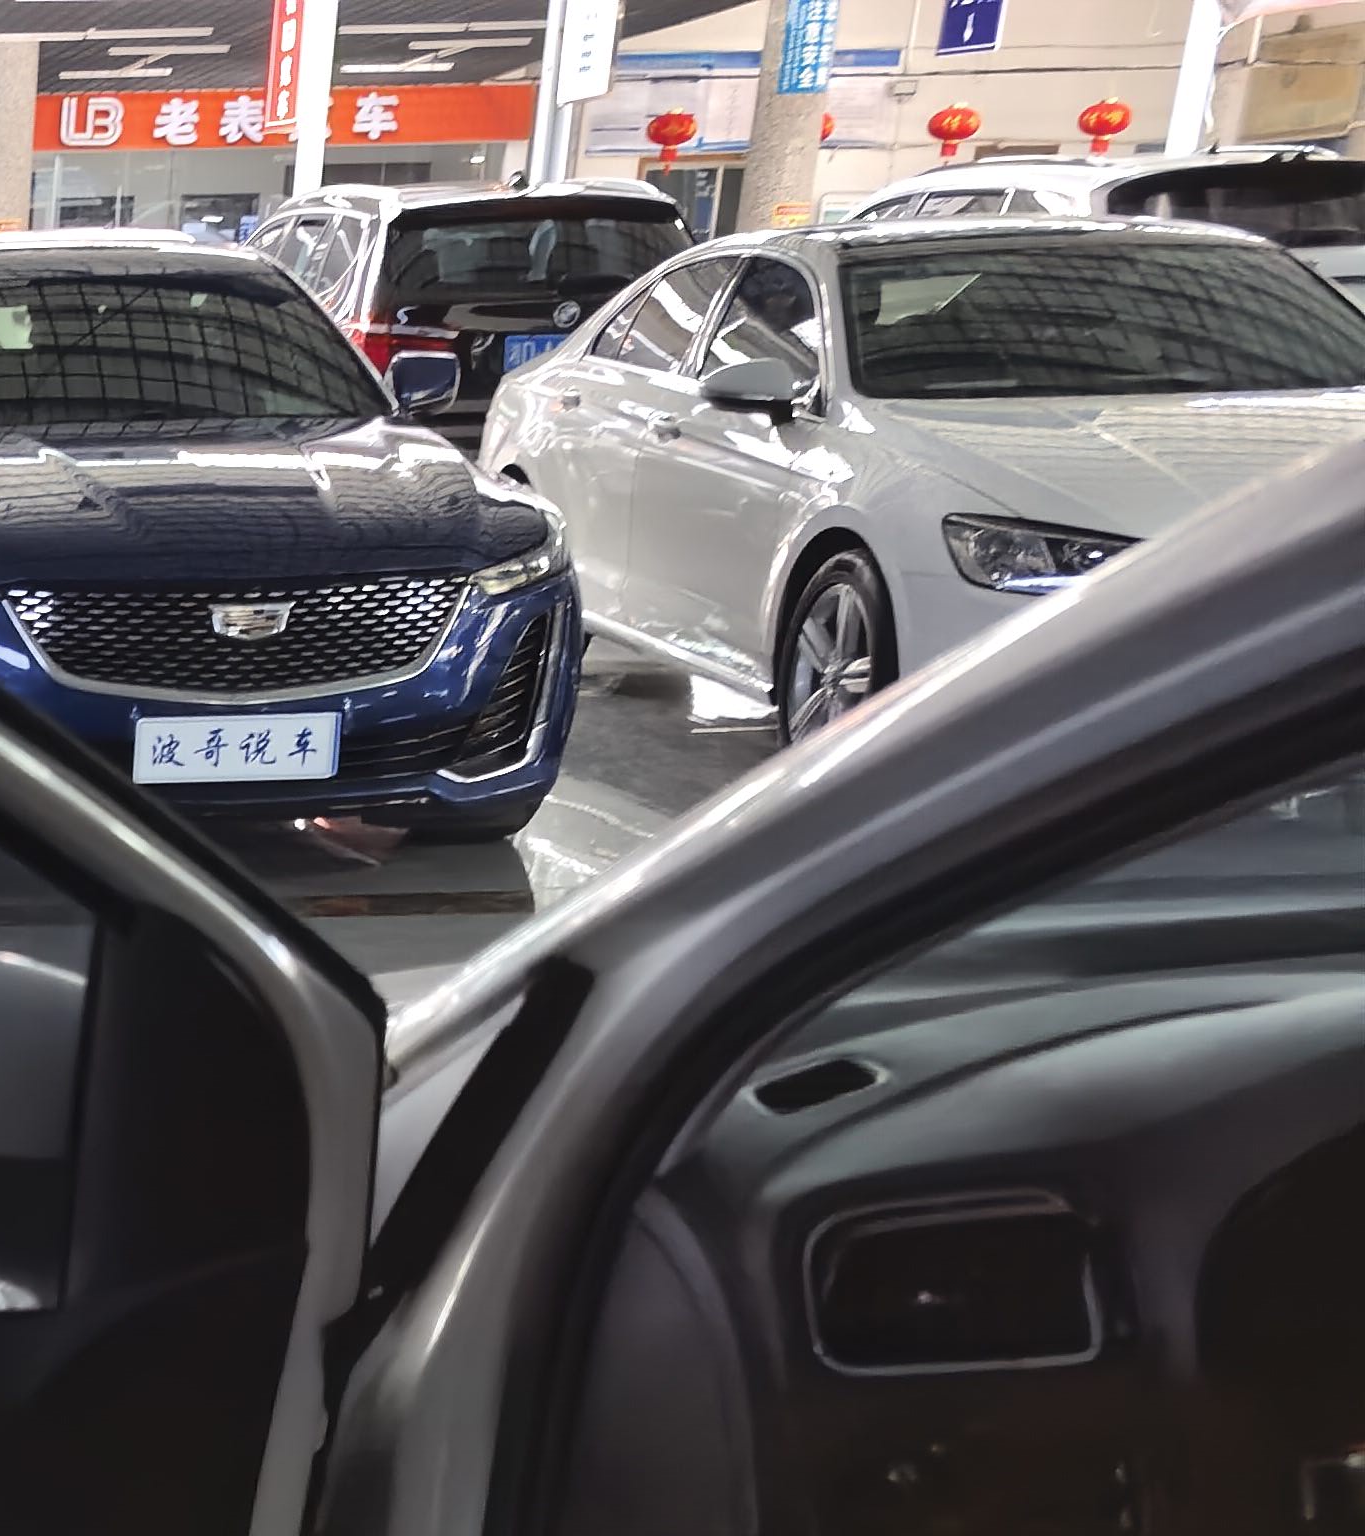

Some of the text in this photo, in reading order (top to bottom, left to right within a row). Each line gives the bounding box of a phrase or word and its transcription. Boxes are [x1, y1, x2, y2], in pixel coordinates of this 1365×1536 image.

[152, 91, 400, 146] 老表车
[151, 726, 317, 768] 波哥说车
